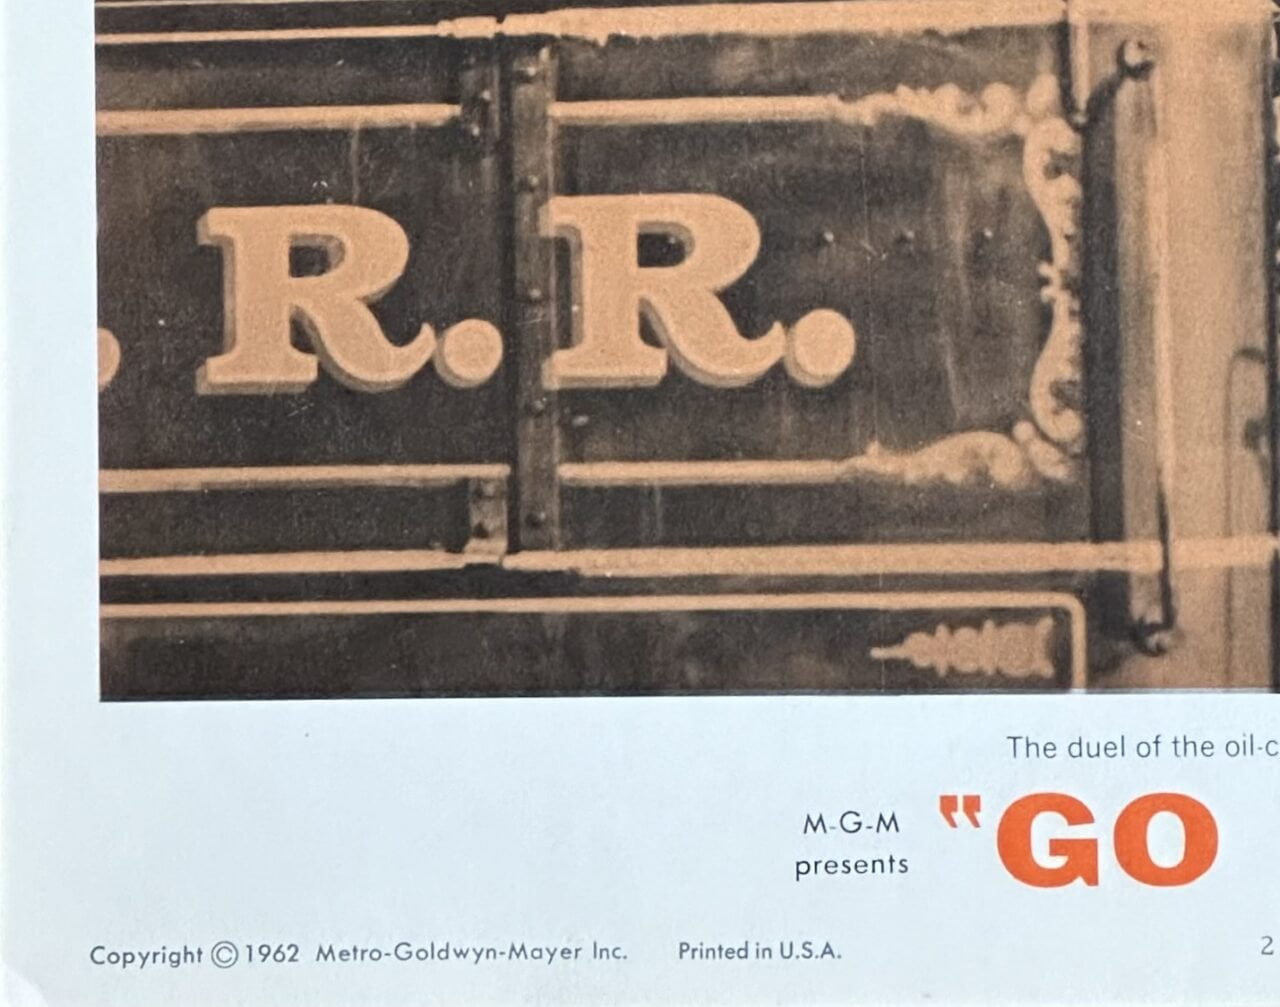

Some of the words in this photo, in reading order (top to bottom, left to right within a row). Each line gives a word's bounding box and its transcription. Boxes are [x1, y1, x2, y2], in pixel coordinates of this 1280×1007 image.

[1006, 736, 1056, 759] The
[1068, 735, 1125, 758] duel
[1136, 735, 1161, 758] of
[1172, 735, 1214, 757] the
[803, 811, 899, 834] M-G-M
[796, 855, 908, 882] presents
[90, 944, 203, 970] Copyright
[316, 942, 582, 965] Metro-Goldwyn-Mayer
[593, 941, 627, 960] Inc.
[679, 941, 748, 960] Printed
[756, 942, 772, 960] in
[780, 941, 841, 960] U.S.A.
[1260, 935, 1275, 956] 2
